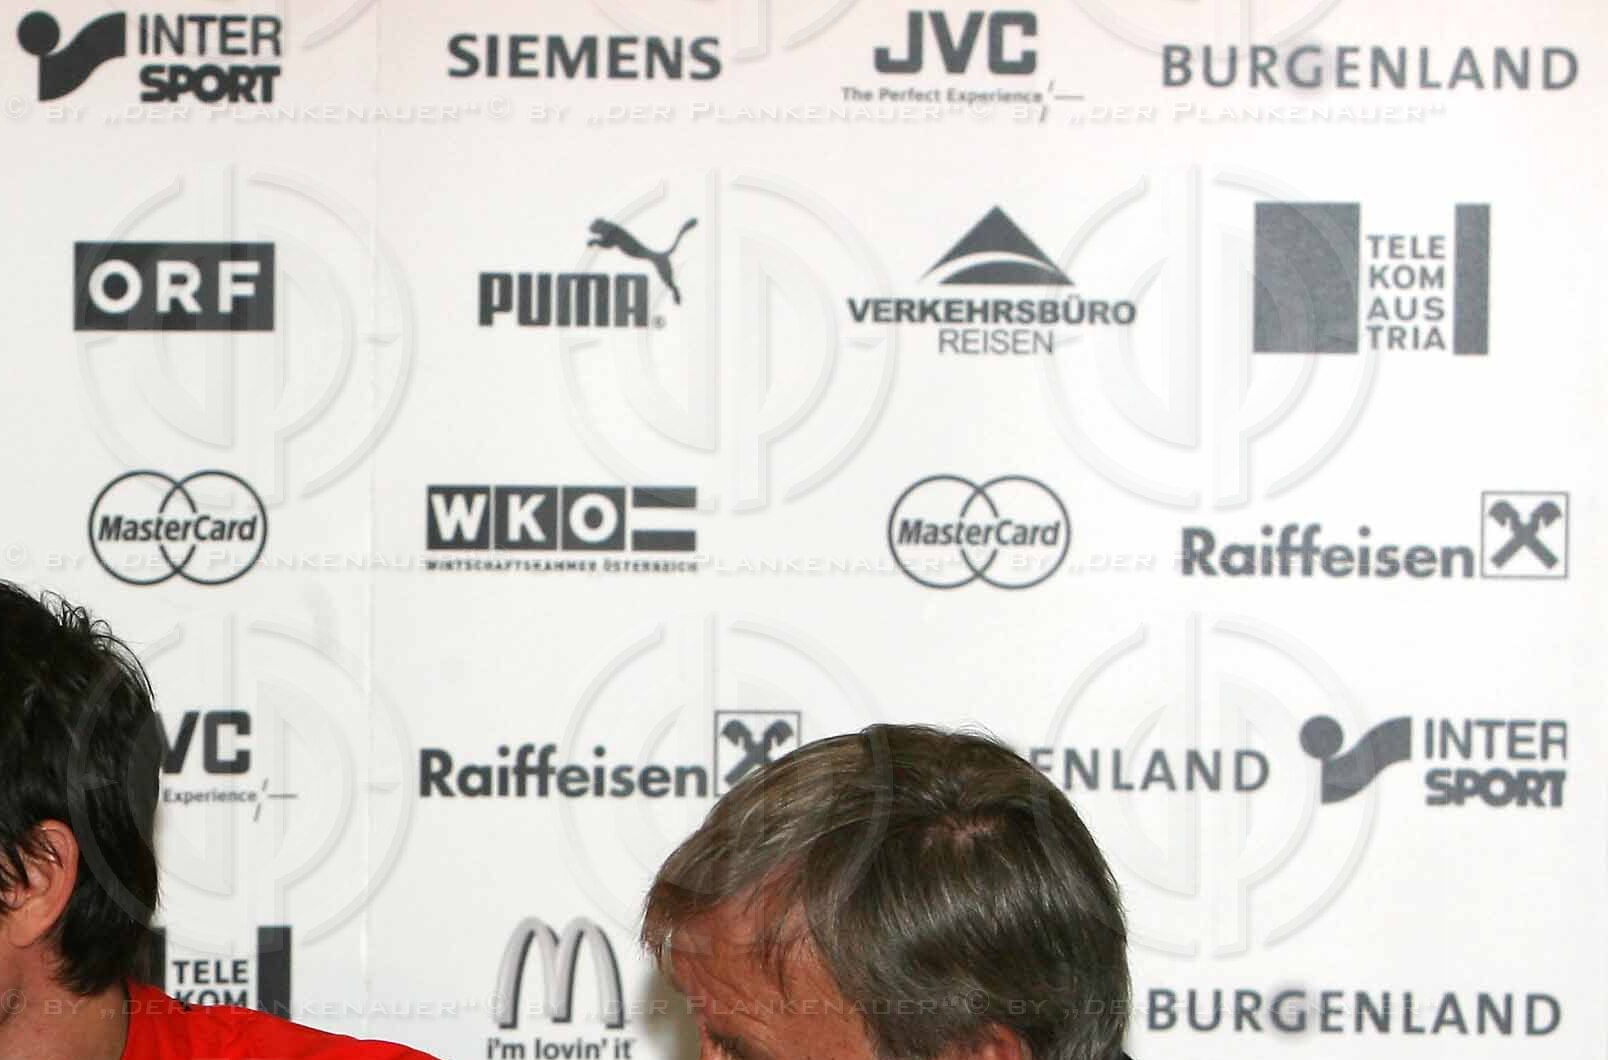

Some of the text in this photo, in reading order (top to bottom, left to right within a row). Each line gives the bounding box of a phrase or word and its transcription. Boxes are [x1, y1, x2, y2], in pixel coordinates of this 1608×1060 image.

[140, 15, 281, 56] INTER
[874, 11, 1037, 75] JVC
[448, 34, 722, 80] SIEMENS
[1162, 44, 1579, 90] BURGENLAND
[140, 64, 280, 103] SPORT
[842, 87, 1043, 105] The Perfect Experience
[1368, 235, 1446, 260] TELE
[89, 260, 261, 313] ORF
[1369, 265, 1445, 289] KOM
[479, 272, 648, 327] PUMA
[848, 298, 1136, 325] VERKEHRSBÜRO
[1368, 297, 1445, 321] AUS
[938, 330, 1054, 354] REISEN
[1367, 325, 1446, 350] TRIA
[98, 513, 258, 545] MasterCard
[430, 492, 619, 543] WKO
[897, 518, 1061, 546] MasterCard
[1181, 524, 1474, 578] Raiffeisen
[156, 711, 251, 774] VC
[1425, 718, 1568, 760] INTER
[420, 744, 708, 798] Raiffeisen
[1425, 767, 1567, 808] SPORT
[173, 960, 249, 984] TELE
[1147, 988, 1561, 1036] BURGENLAND
[615, 1038, 632, 1060] it
